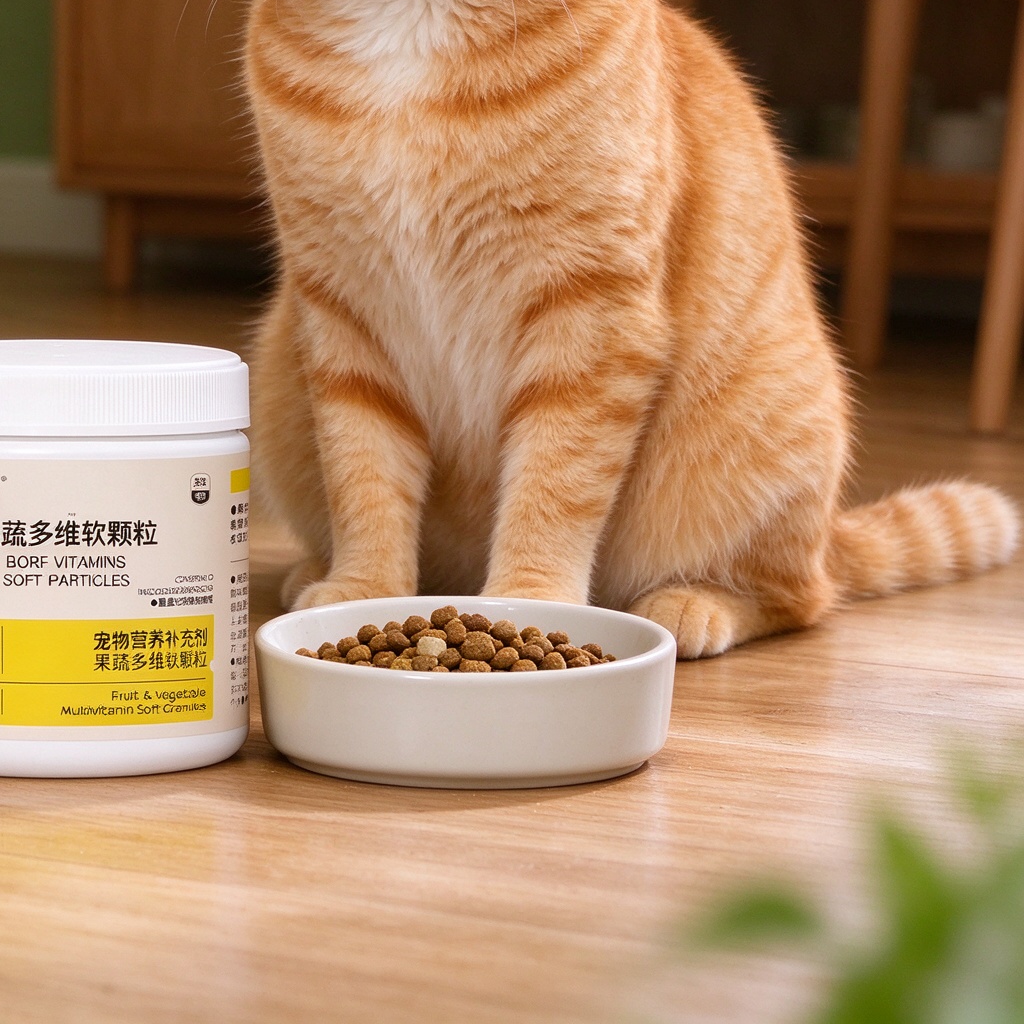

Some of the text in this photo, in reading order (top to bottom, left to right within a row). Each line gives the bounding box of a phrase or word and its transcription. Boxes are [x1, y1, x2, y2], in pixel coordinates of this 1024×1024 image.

[6, 556, 126, 569] BORF VITAMINS
[3, 574, 130, 587] SOFT PARTICLES
[93, 628, 208, 650] 宠物营养补充剂
[144, 690, 152, 700] &
